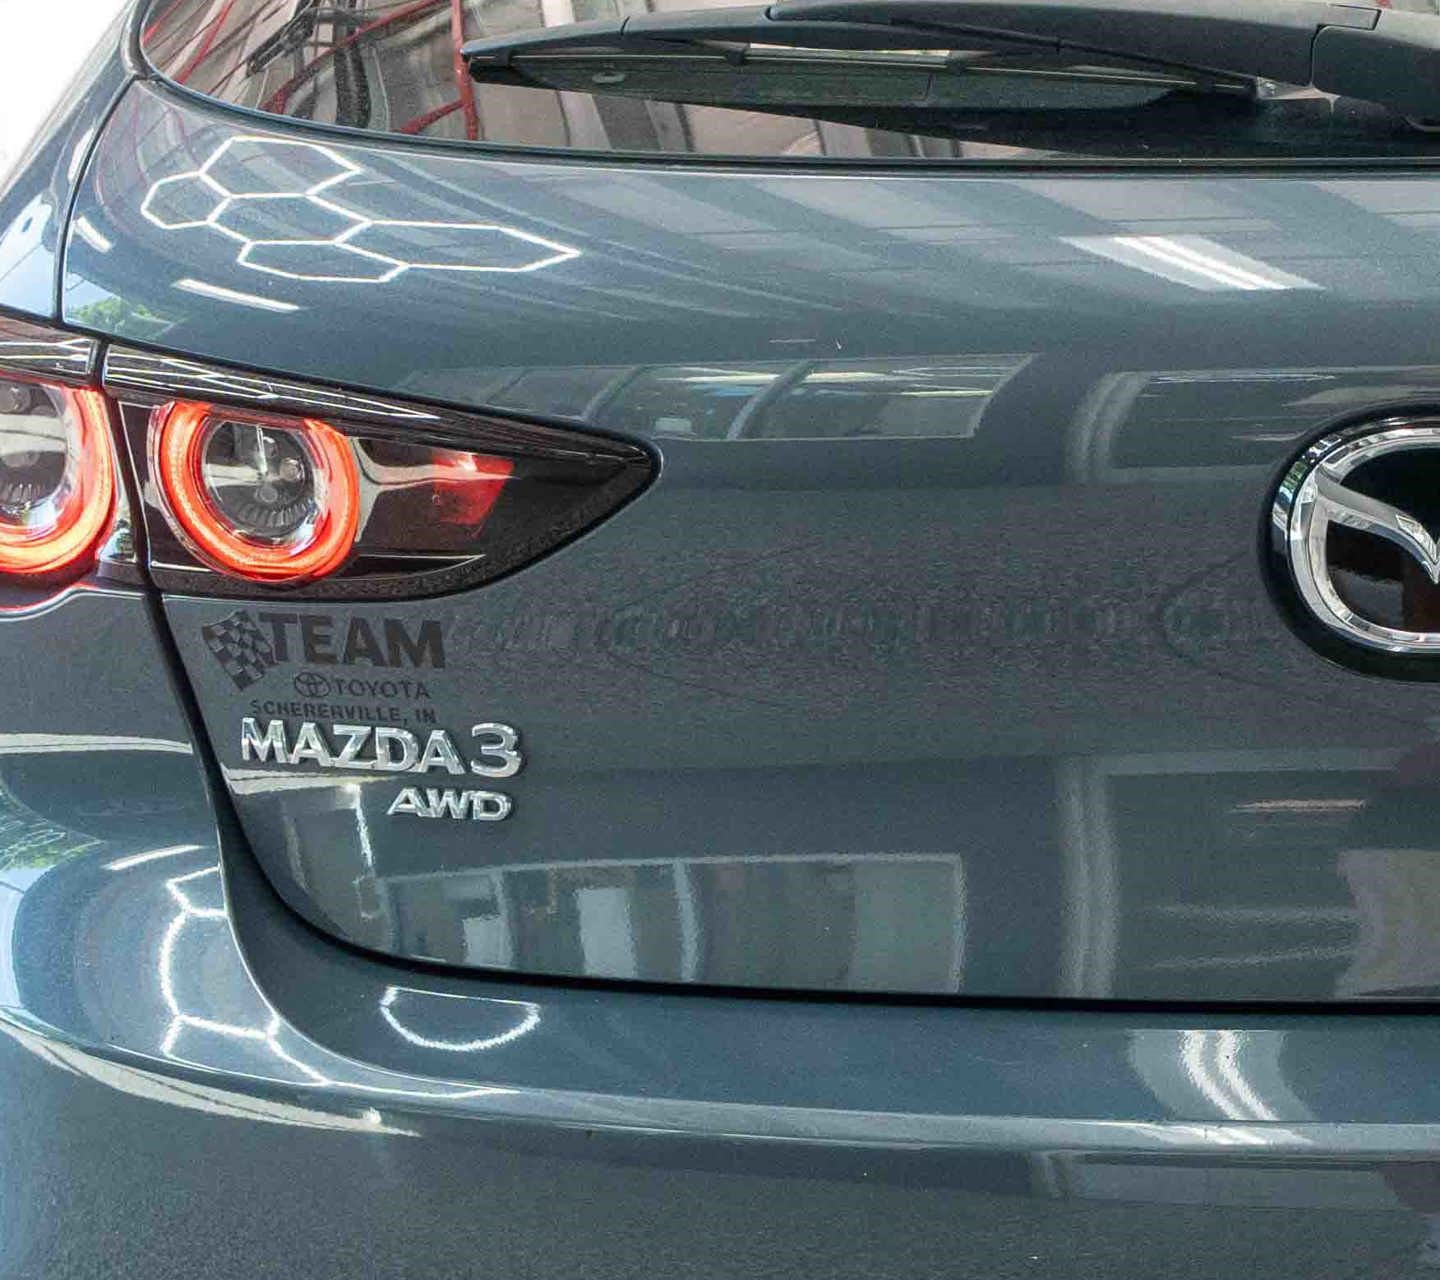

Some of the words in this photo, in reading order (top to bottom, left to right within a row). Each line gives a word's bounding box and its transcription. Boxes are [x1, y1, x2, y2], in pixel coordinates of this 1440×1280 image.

[258, 612, 446, 669] TEAM
[334, 678, 432, 700] TOYOTA
[416, 707, 437, 724] IN
[240, 716, 466, 775] MAZDA
[386, 787, 514, 822] AWD
